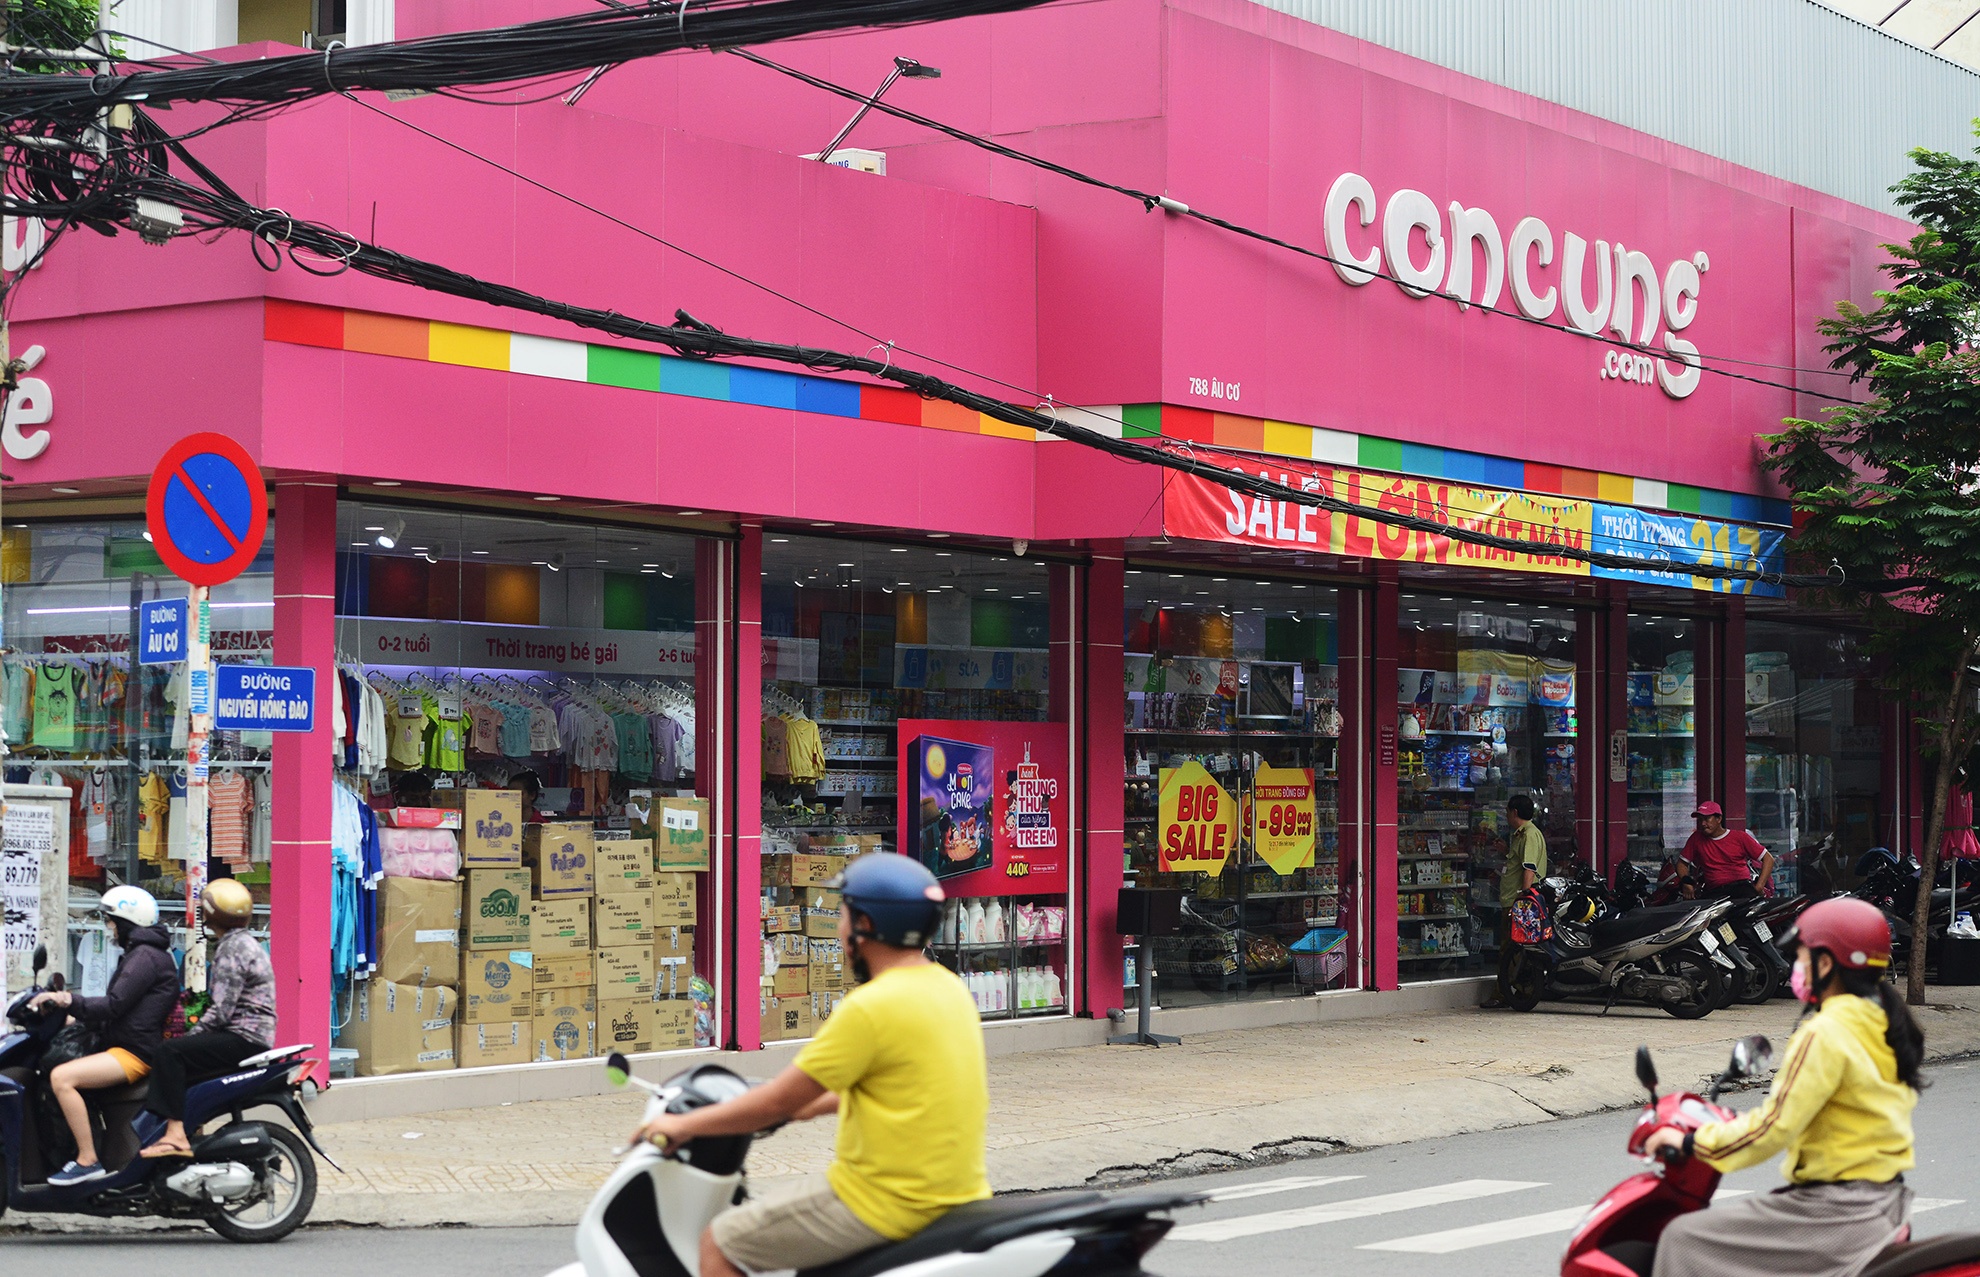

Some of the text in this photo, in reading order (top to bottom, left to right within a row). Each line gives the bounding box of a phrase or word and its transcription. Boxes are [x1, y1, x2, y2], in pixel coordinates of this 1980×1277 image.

[1189, 376, 1241, 402] 788 ÂU CƠ
[1225, 466, 1449, 565] SALE LỚN
[1456, 503, 1523, 562] NHẤT
[150, 606, 177, 624] ĐƯỜNG
[147, 629, 163, 653] ÂU
[164, 630, 179, 652] CƠ
[378, 633, 431, 653] 0-2 tuổi
[485, 638, 618, 664] Thời trang bé gái
[658, 649, 678, 663] 2-6
[240, 672, 291, 691] ĐƯỜNG
[1187, 669, 1202, 685] Xe
[1496, 684, 1518, 698] Bobby
[218, 693, 308, 720] NGUYỄN HỒNG ĐÀO
[1018, 780, 1058, 799] TRUNG
[1265, 788, 1282, 798] TRANG
[1282, 786, 1297, 798] ĐỒNG
[1018, 796, 1042, 813] THU
[1177, 785, 1219, 822] BIG
[1040, 829, 1056, 845] EM
[1164, 823, 1227, 862] SALE
[1006, 862, 1030, 877] 440K
[485, 970, 512, 982] Merries
[785, 1010, 799, 1020] BON
[612, 1018, 640, 1033] Pampers
[785, 1020, 798, 1030] AMI
